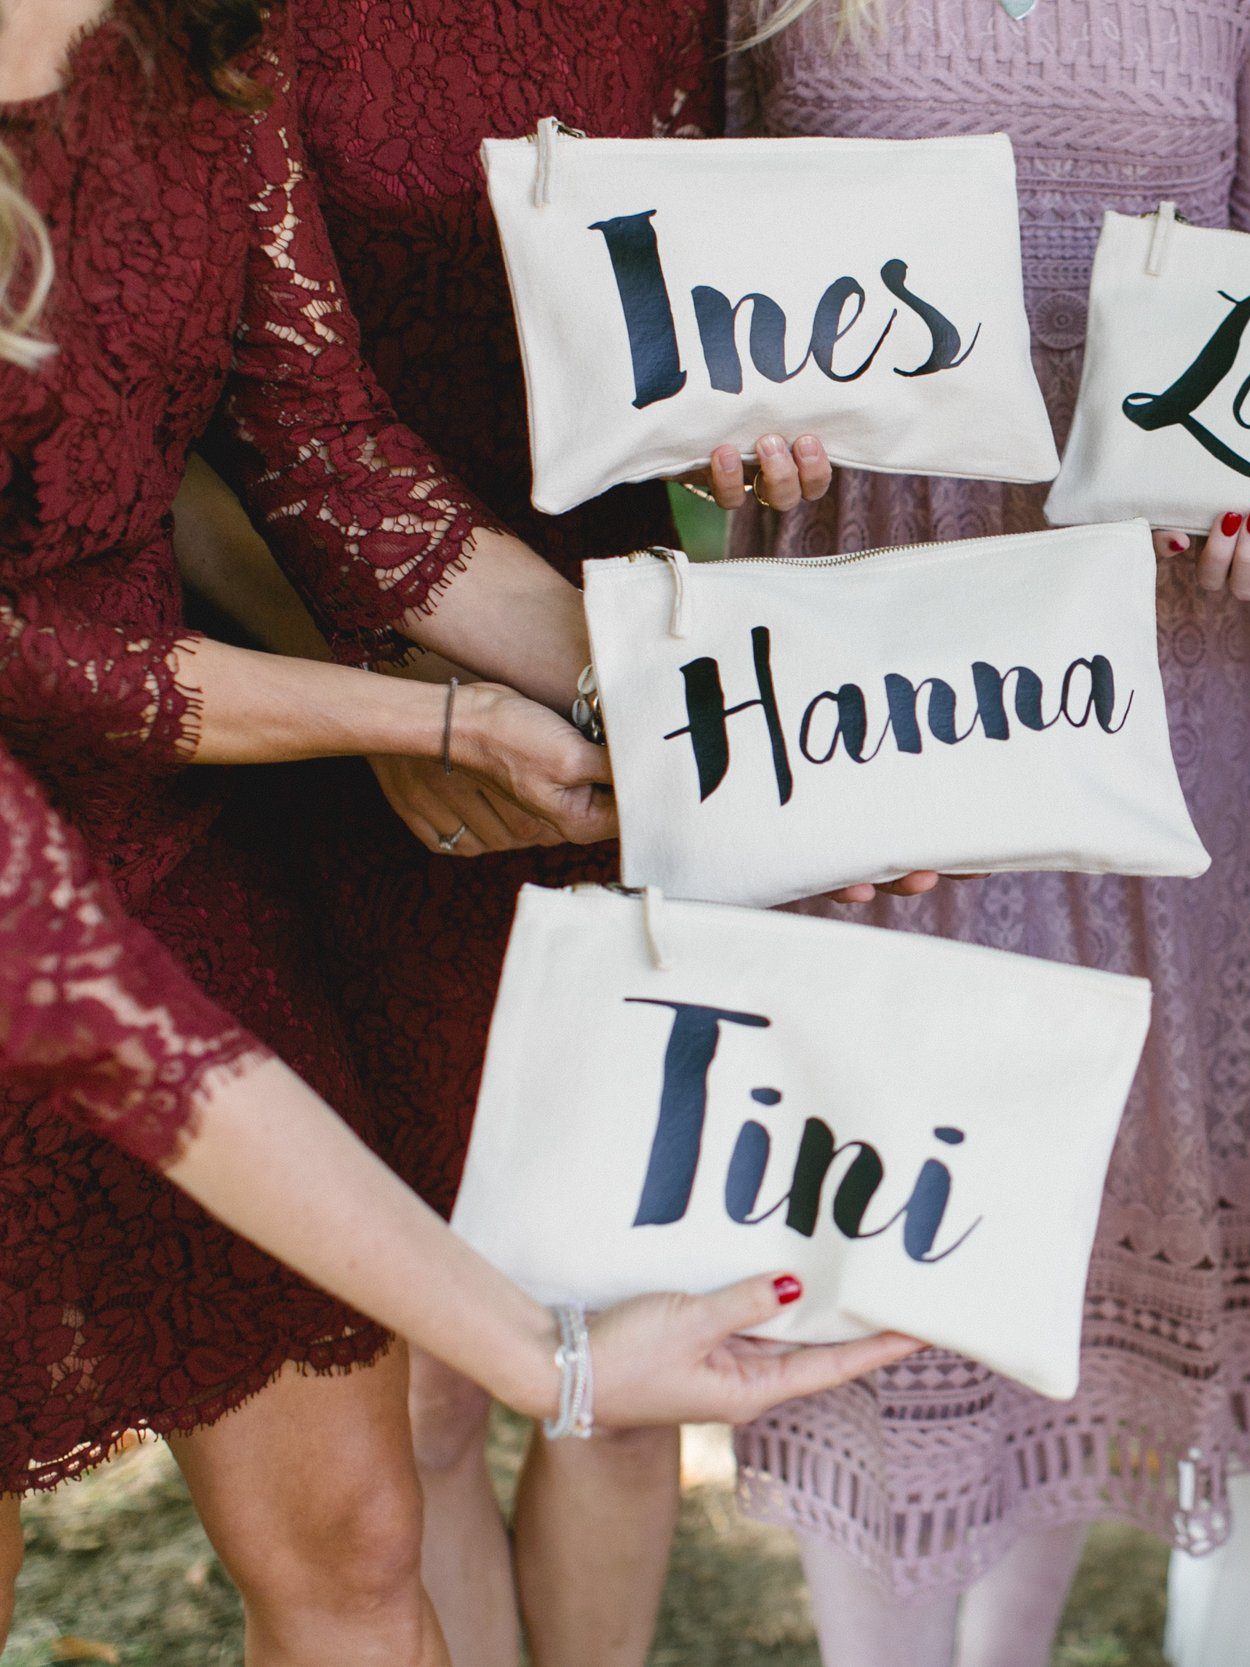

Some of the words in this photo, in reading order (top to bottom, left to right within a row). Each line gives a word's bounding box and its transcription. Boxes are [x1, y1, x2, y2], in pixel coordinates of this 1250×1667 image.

[586, 208, 983, 411] Ines
[663, 625, 1136, 808] Hanna
[624, 996, 984, 1264] Tini
